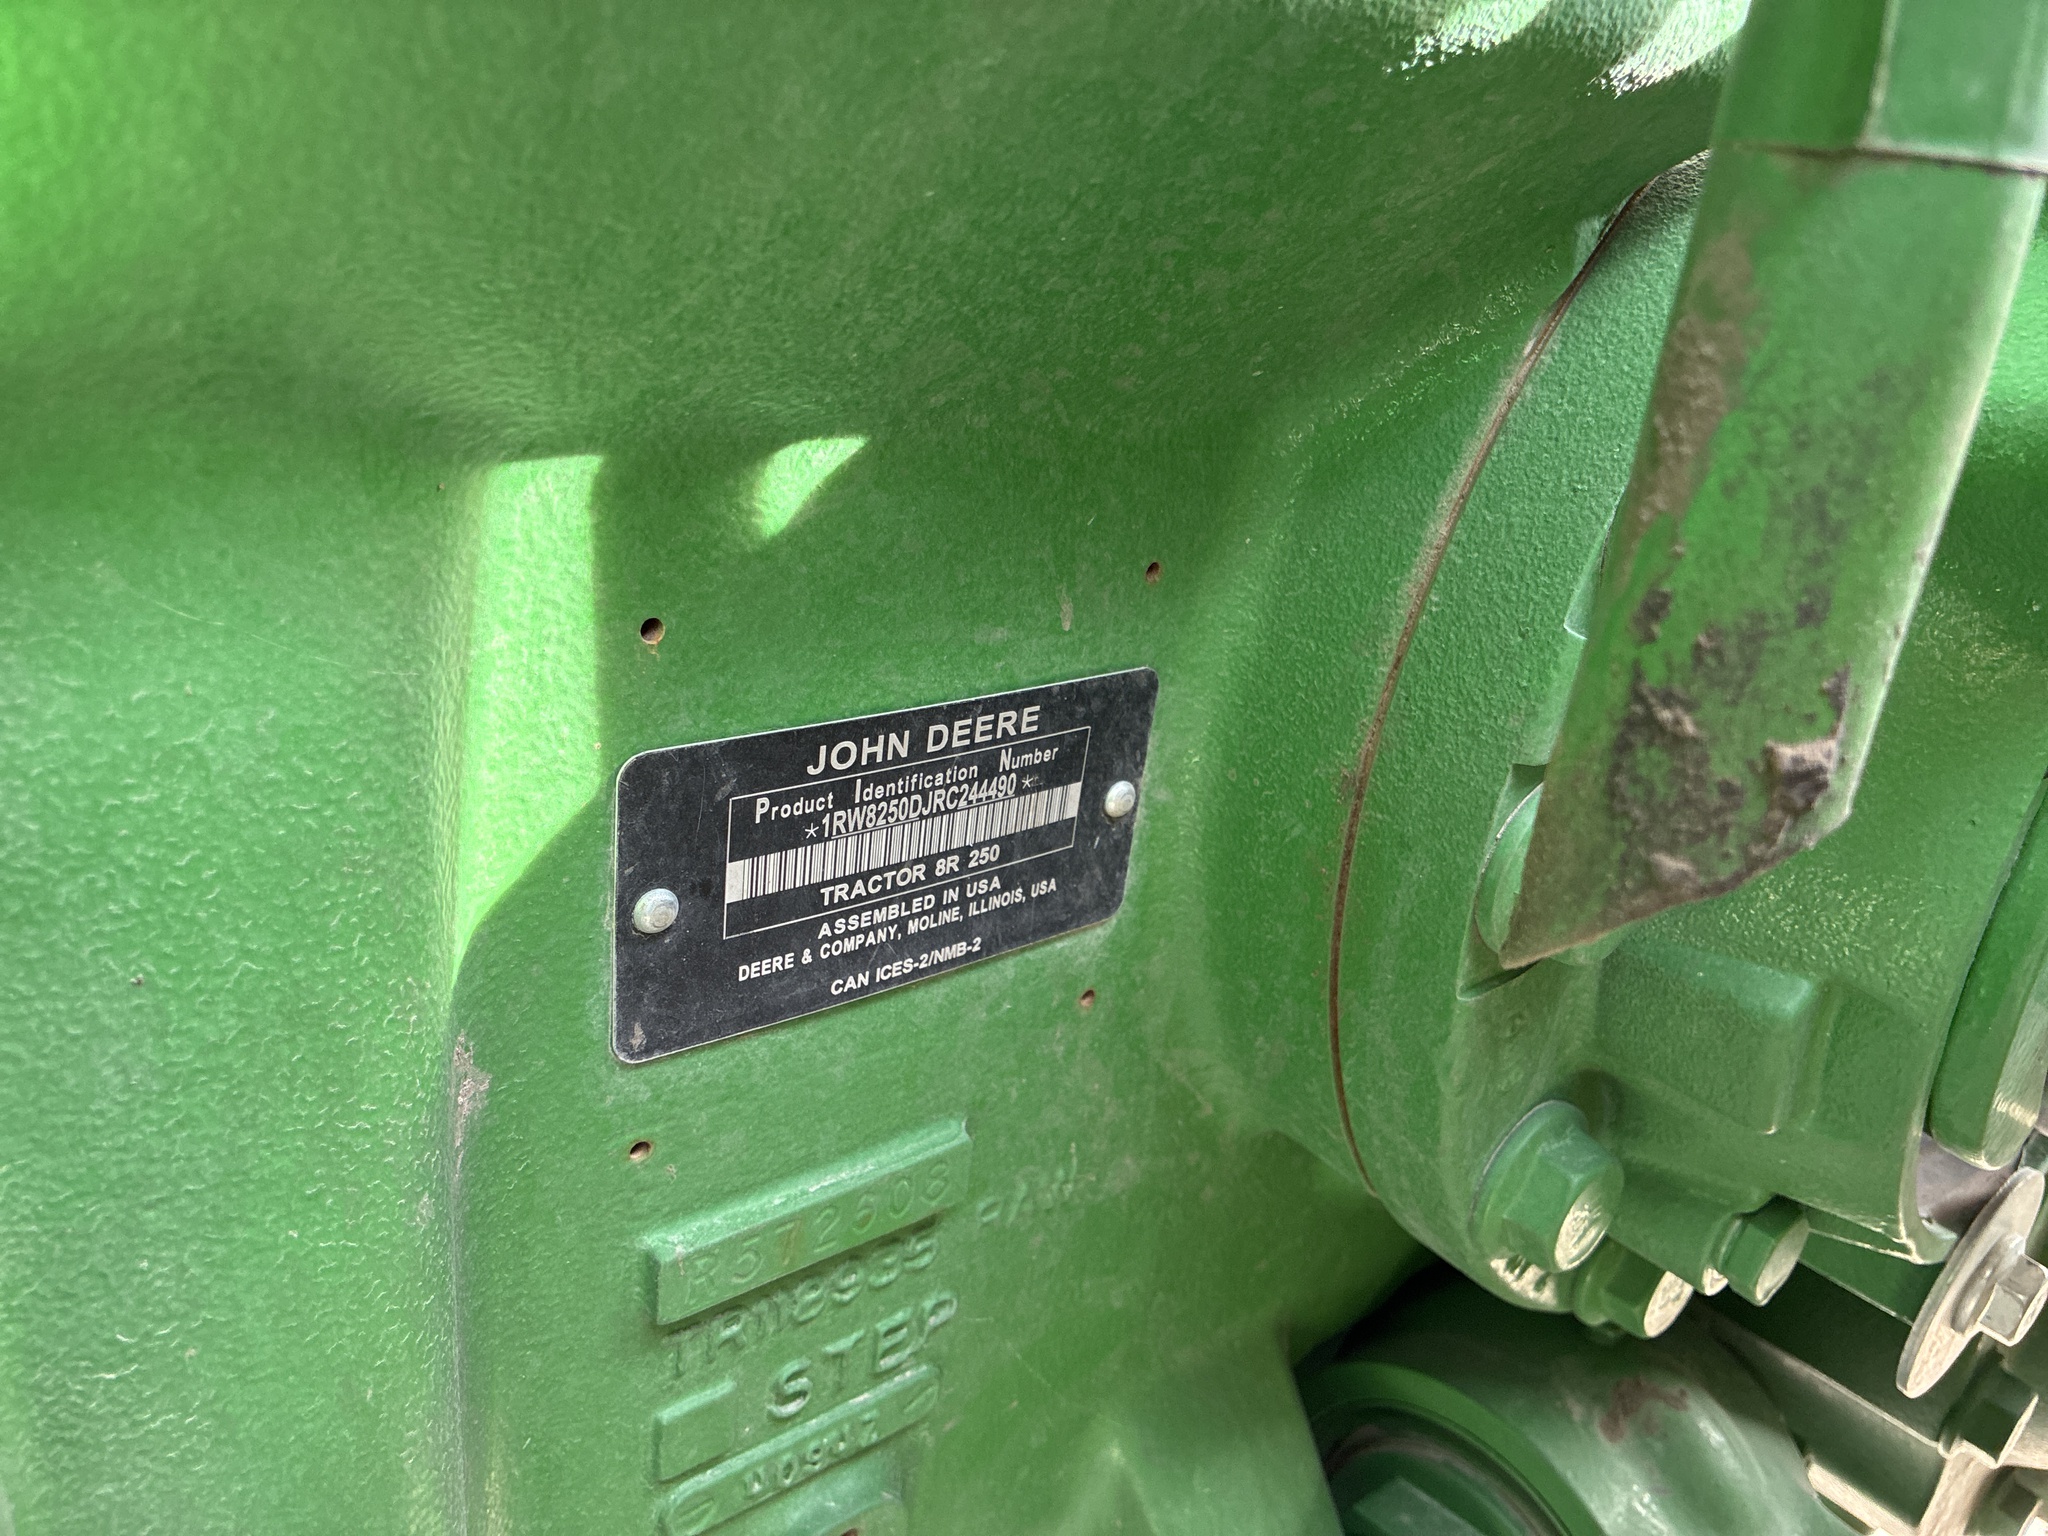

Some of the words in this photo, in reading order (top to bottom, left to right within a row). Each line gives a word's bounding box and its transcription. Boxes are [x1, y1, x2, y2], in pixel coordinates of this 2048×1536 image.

[806, 730, 910, 776] JOHN
[926, 705, 1041, 753] DEERE
[755, 791, 834, 824] Product
[854, 764, 978, 804] Identification
[999, 747, 1059, 772] Number
[817, 894, 936, 939] ASSEMBLED
[942, 886, 959, 905] IN
[966, 876, 1001, 897] USA
[820, 864, 926, 906] TRACTOR
[934, 855, 960, 877] 8R
[968, 844, 1000, 868] 250
[738, 953, 795, 982] DEERE
[801, 948, 813, 964] &
[819, 924, 902, 959] COMPANY,
[907, 907, 963, 935] MOLINE,
[968, 887, 1026, 917] ILLINOIS,
[1030, 878, 1057, 897] USA
[830, 971, 870, 995] CAN
[875, 937, 982, 982] ICES-2/NMB-2
